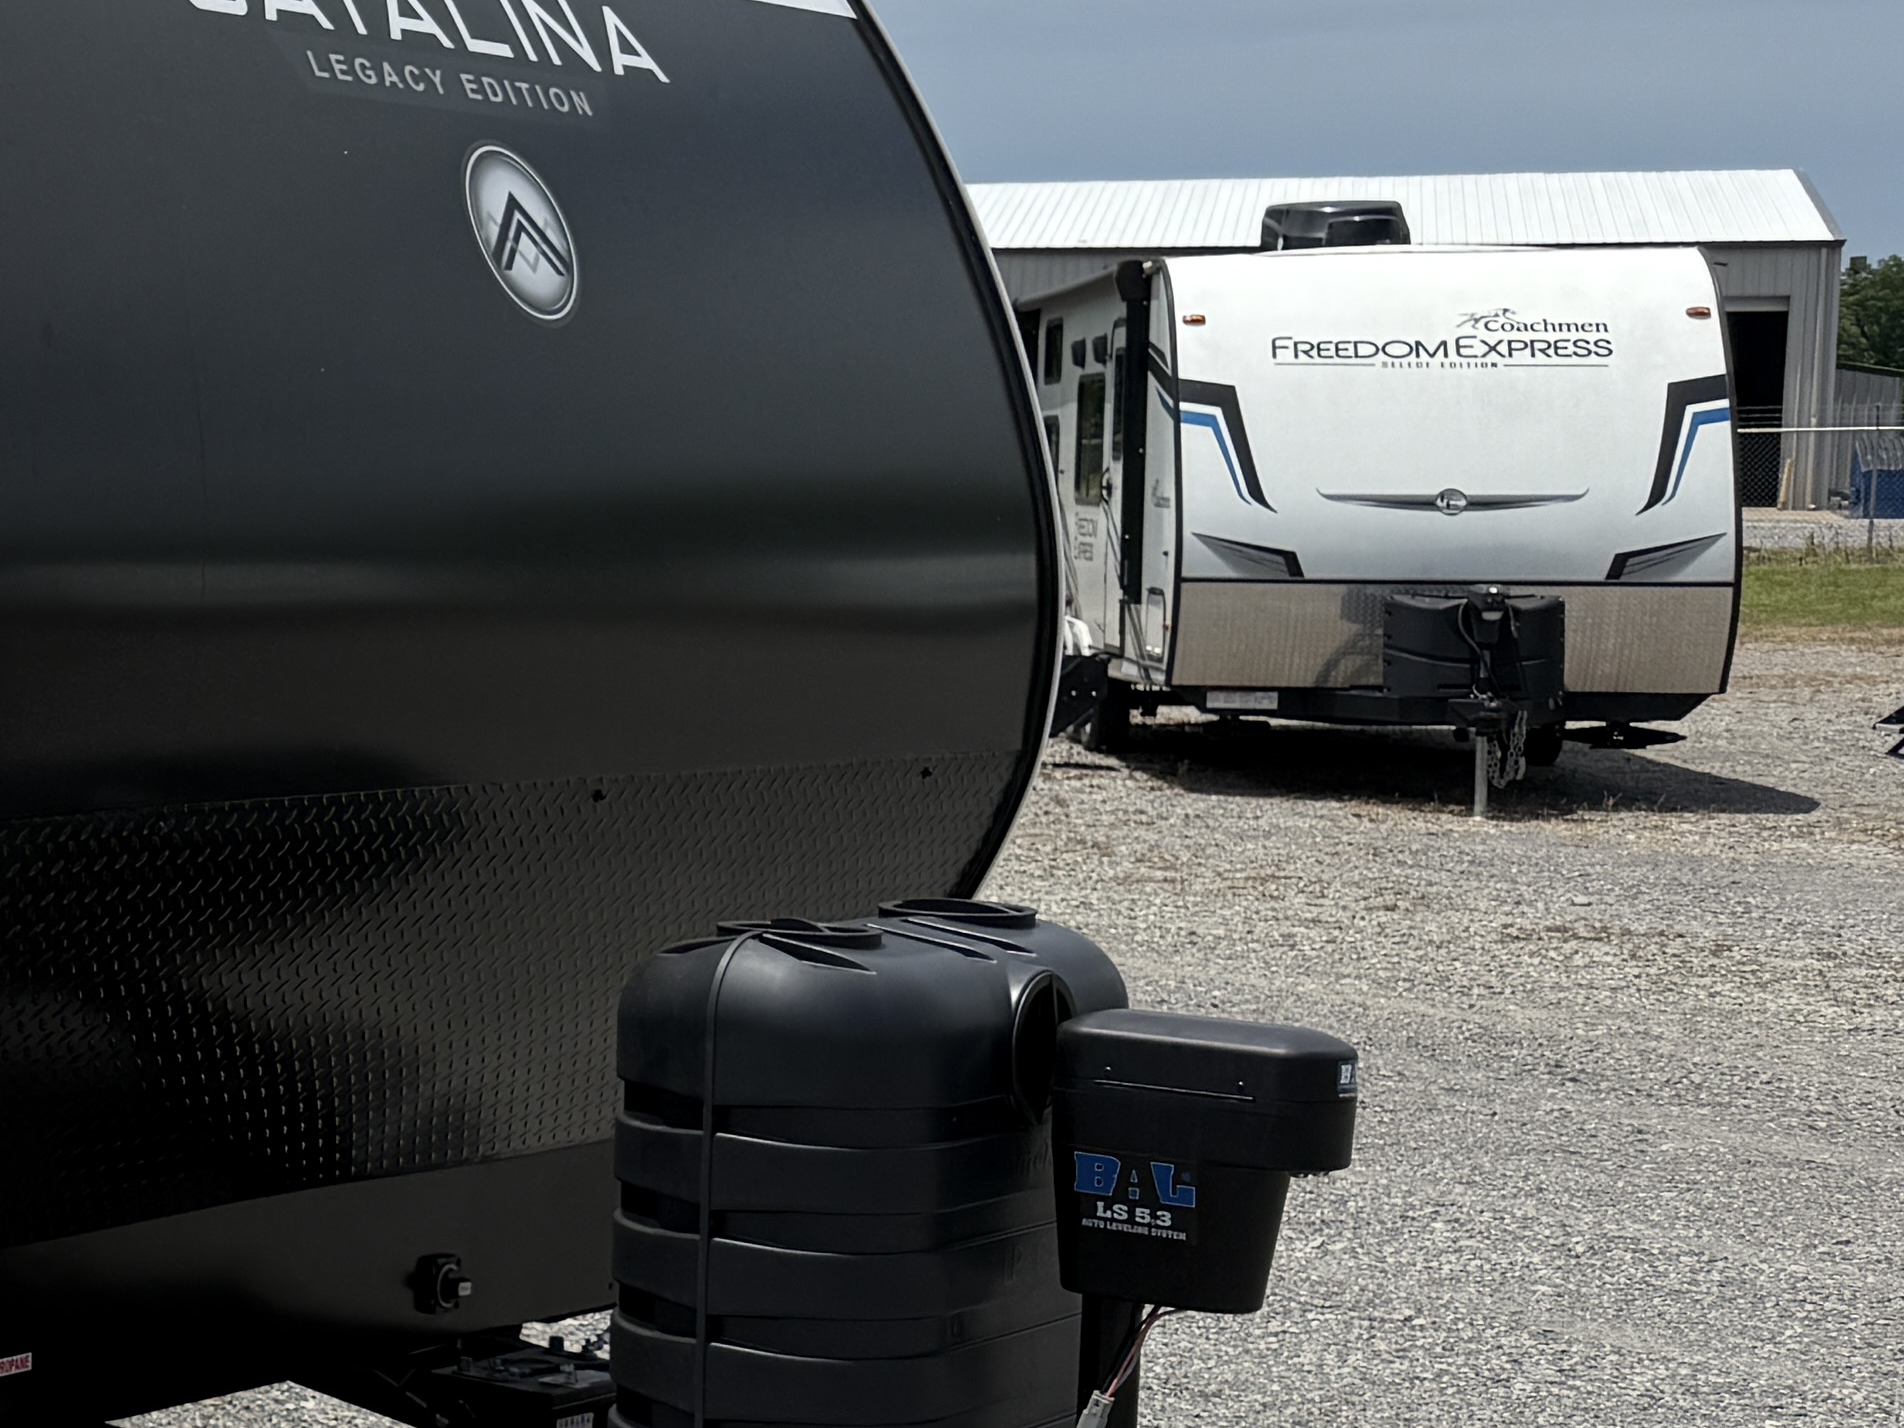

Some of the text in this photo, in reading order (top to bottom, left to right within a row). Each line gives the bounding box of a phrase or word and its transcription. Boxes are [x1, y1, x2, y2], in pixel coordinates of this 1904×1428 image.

[306, 49, 594, 117] LEGACY EDITION
[1483, 318, 1610, 334] Coachmen
[1271, 335, 1614, 360] FREEDOM EXPRESS
[1074, 1151, 1196, 1208] BAL
[1096, 1201, 1129, 1220] LS
